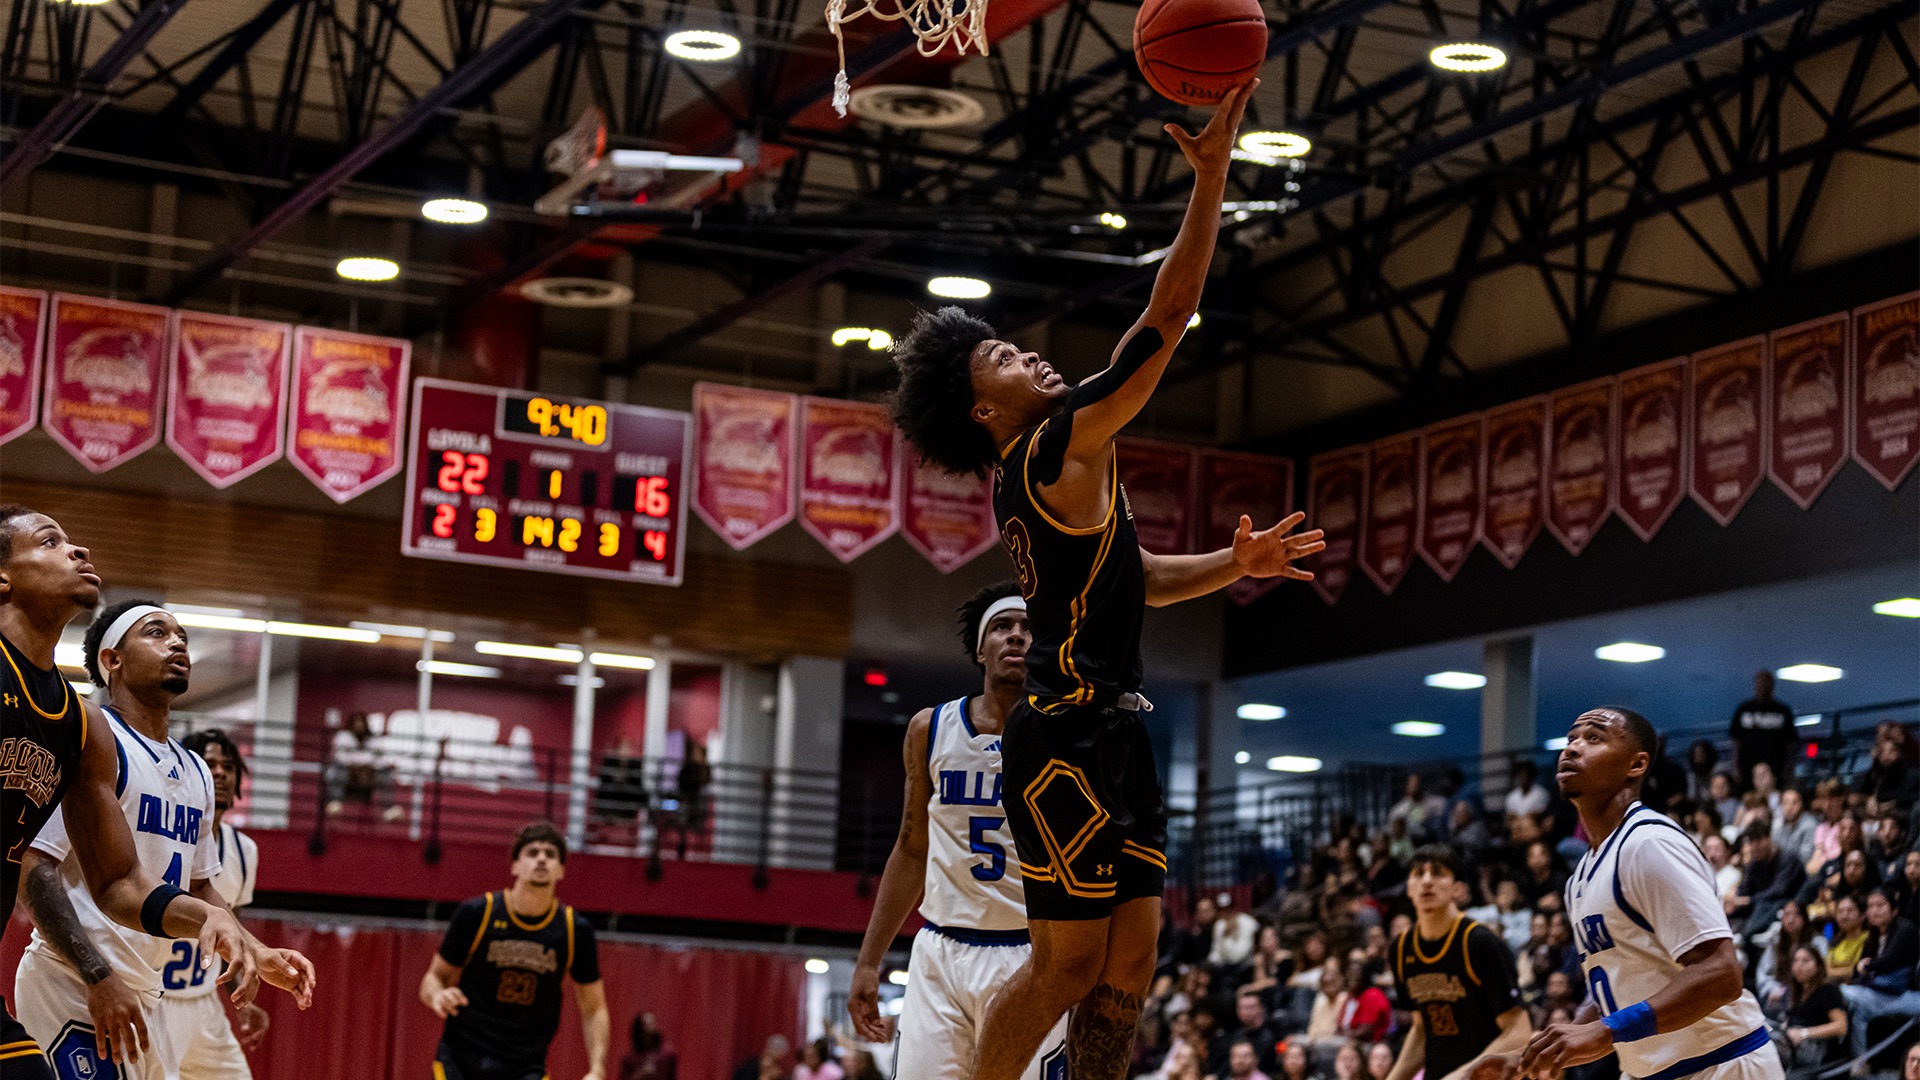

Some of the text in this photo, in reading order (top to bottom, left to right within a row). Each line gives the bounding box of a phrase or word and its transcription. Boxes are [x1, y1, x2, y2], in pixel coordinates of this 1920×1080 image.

[527, 397, 607, 446] 9:40
[438, 449, 489, 496] 22
[549, 469, 563, 499] 1
[634, 475, 670, 518] 16
[432, 503, 457, 538] 2
[474, 507, 497, 543] 3
[598, 522, 620, 557] 3
[643, 529, 666, 560] 4
[939, 770, 1003, 807] DILLA
[969, 815, 1007, 882] 5
